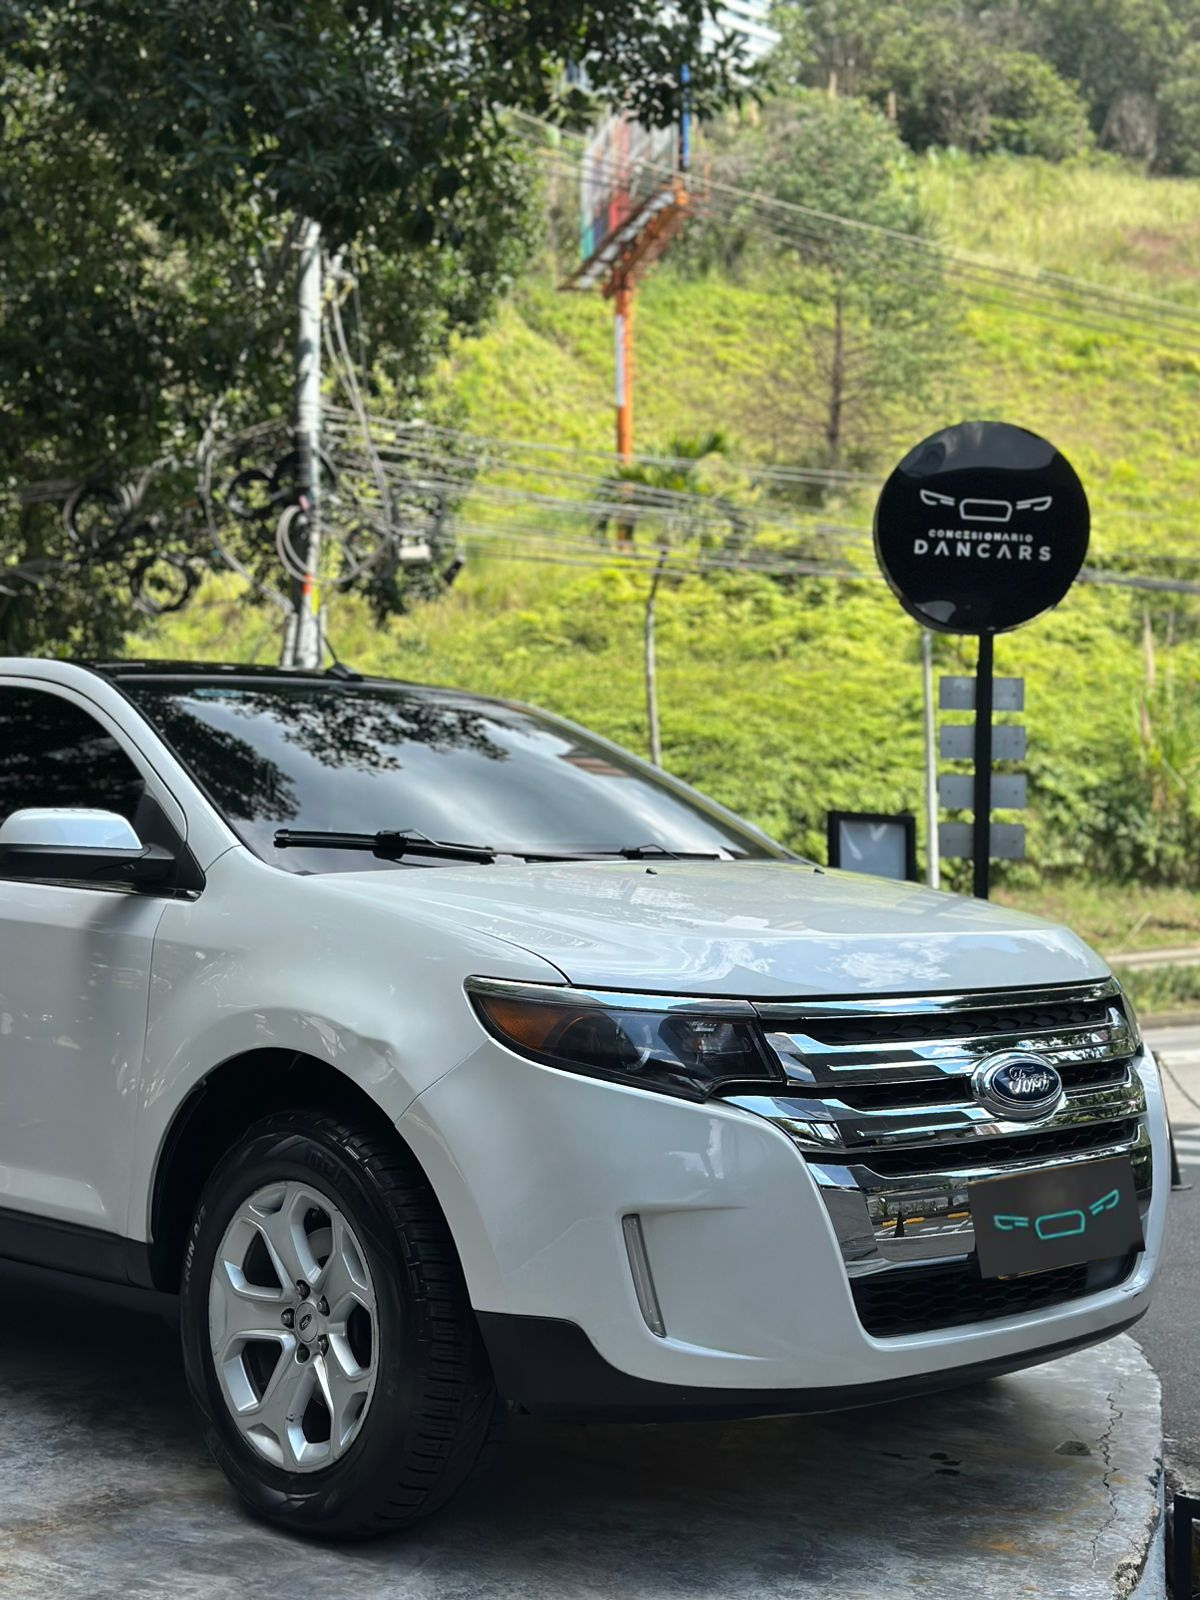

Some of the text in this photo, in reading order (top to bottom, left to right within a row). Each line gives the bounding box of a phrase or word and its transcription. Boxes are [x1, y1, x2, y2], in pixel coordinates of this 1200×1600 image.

[928, 529, 1033, 543] CONCESIONARIO
[913, 539, 1052, 561] DANCARS
[1008, 1066, 1051, 1094] Ford
